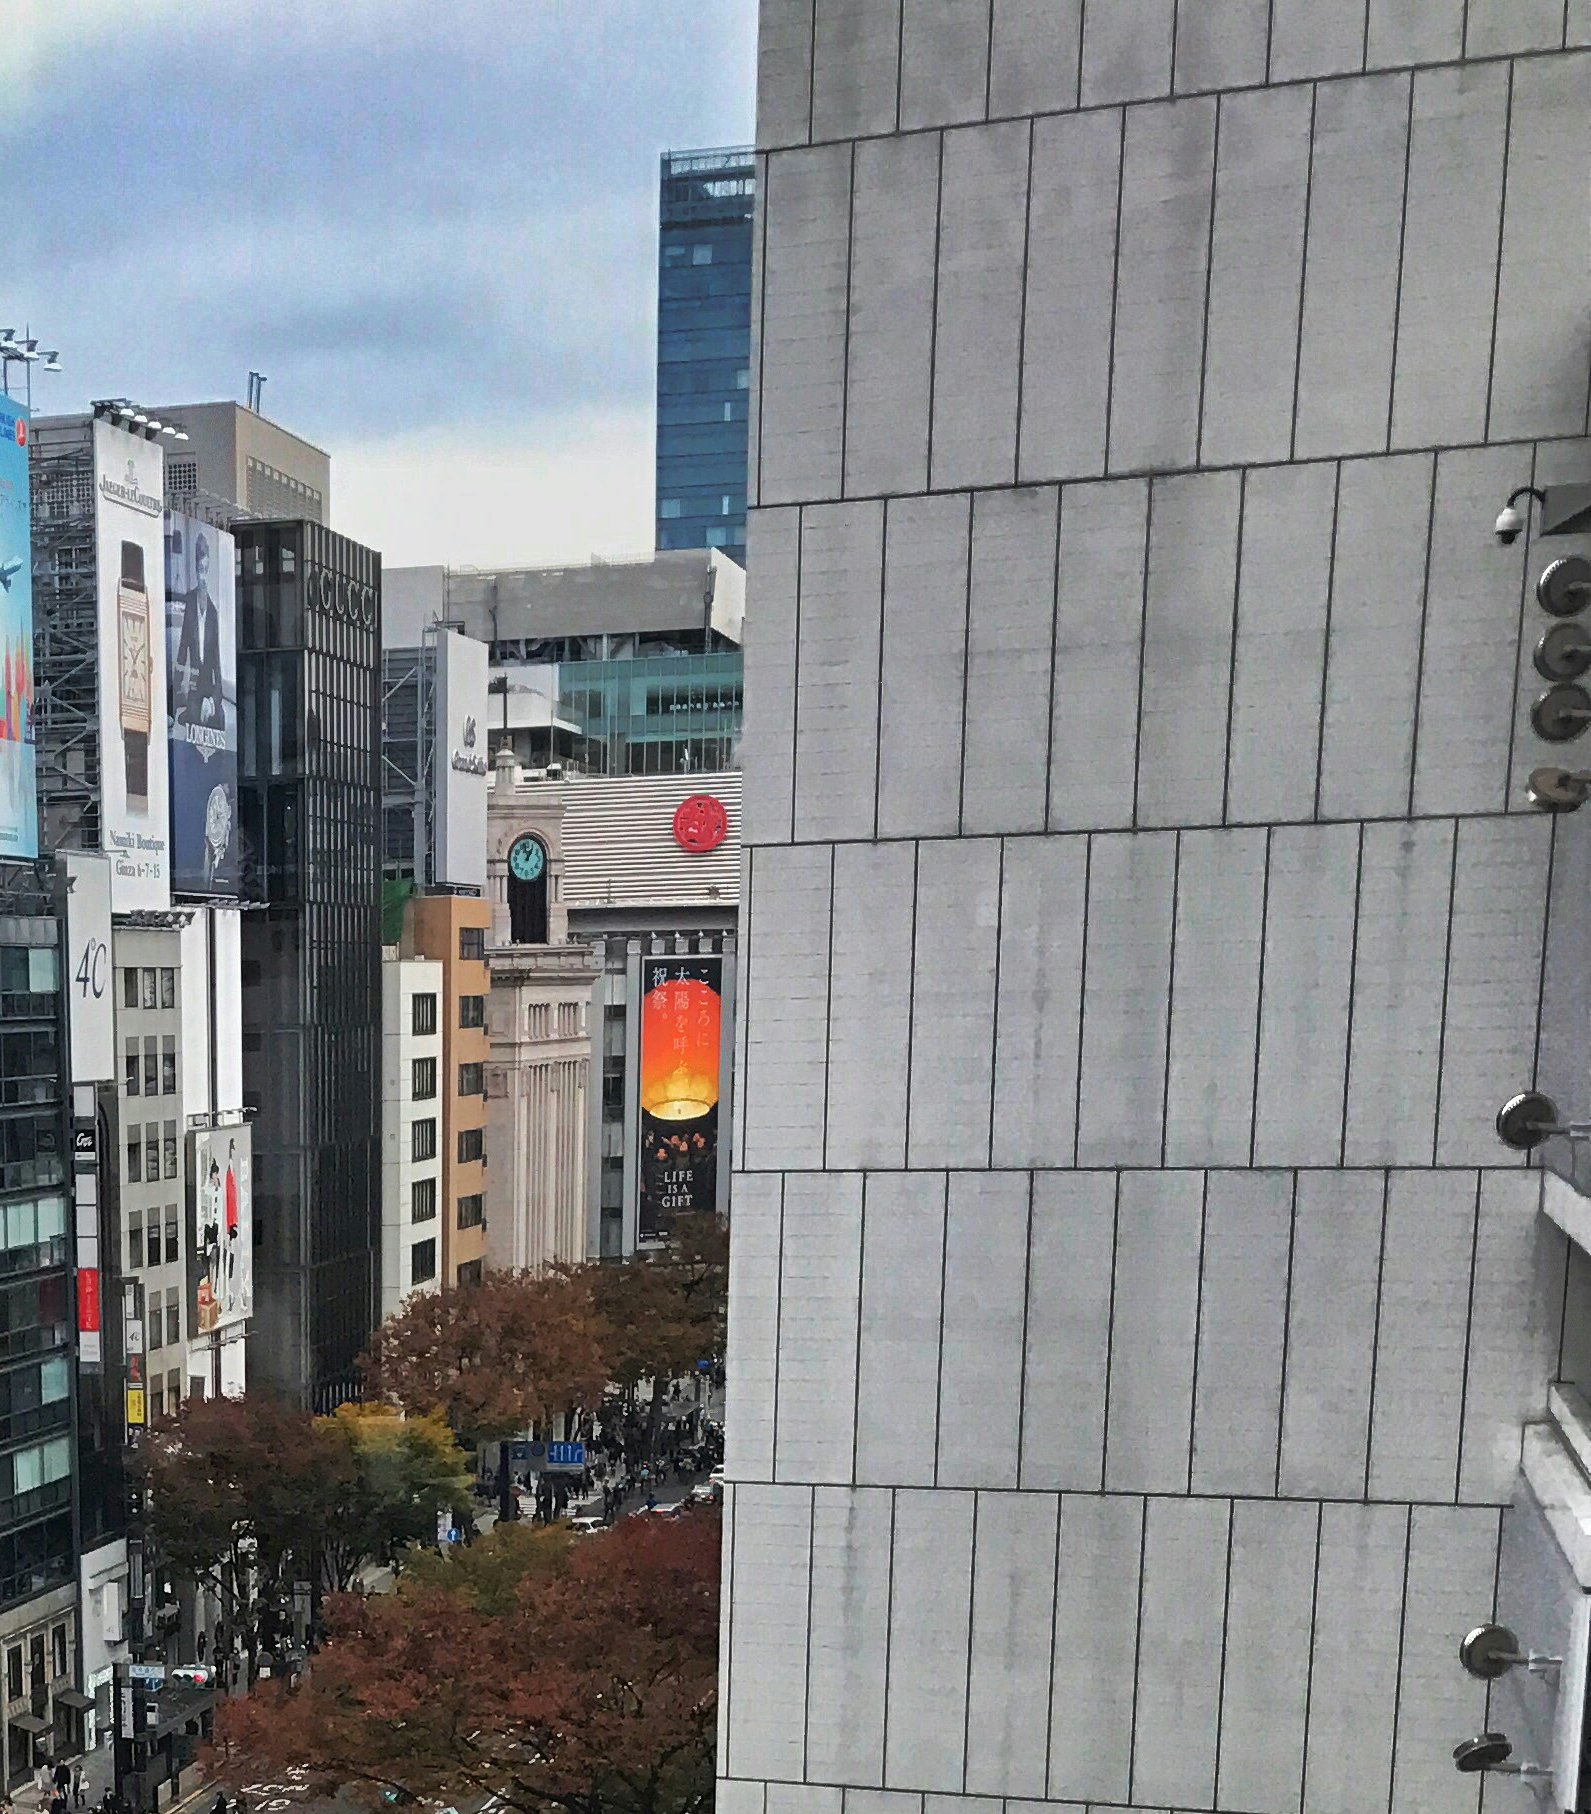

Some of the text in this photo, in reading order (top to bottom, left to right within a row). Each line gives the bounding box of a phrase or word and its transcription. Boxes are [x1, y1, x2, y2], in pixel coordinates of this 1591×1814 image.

[185, 723, 225, 749] LONGINES
[696, 968, 710, 1047] こころに
[664, 1170, 694, 1183] LIFE
[668, 1184, 689, 1193] IS A
[661, 1195, 693, 1208] GIFT
